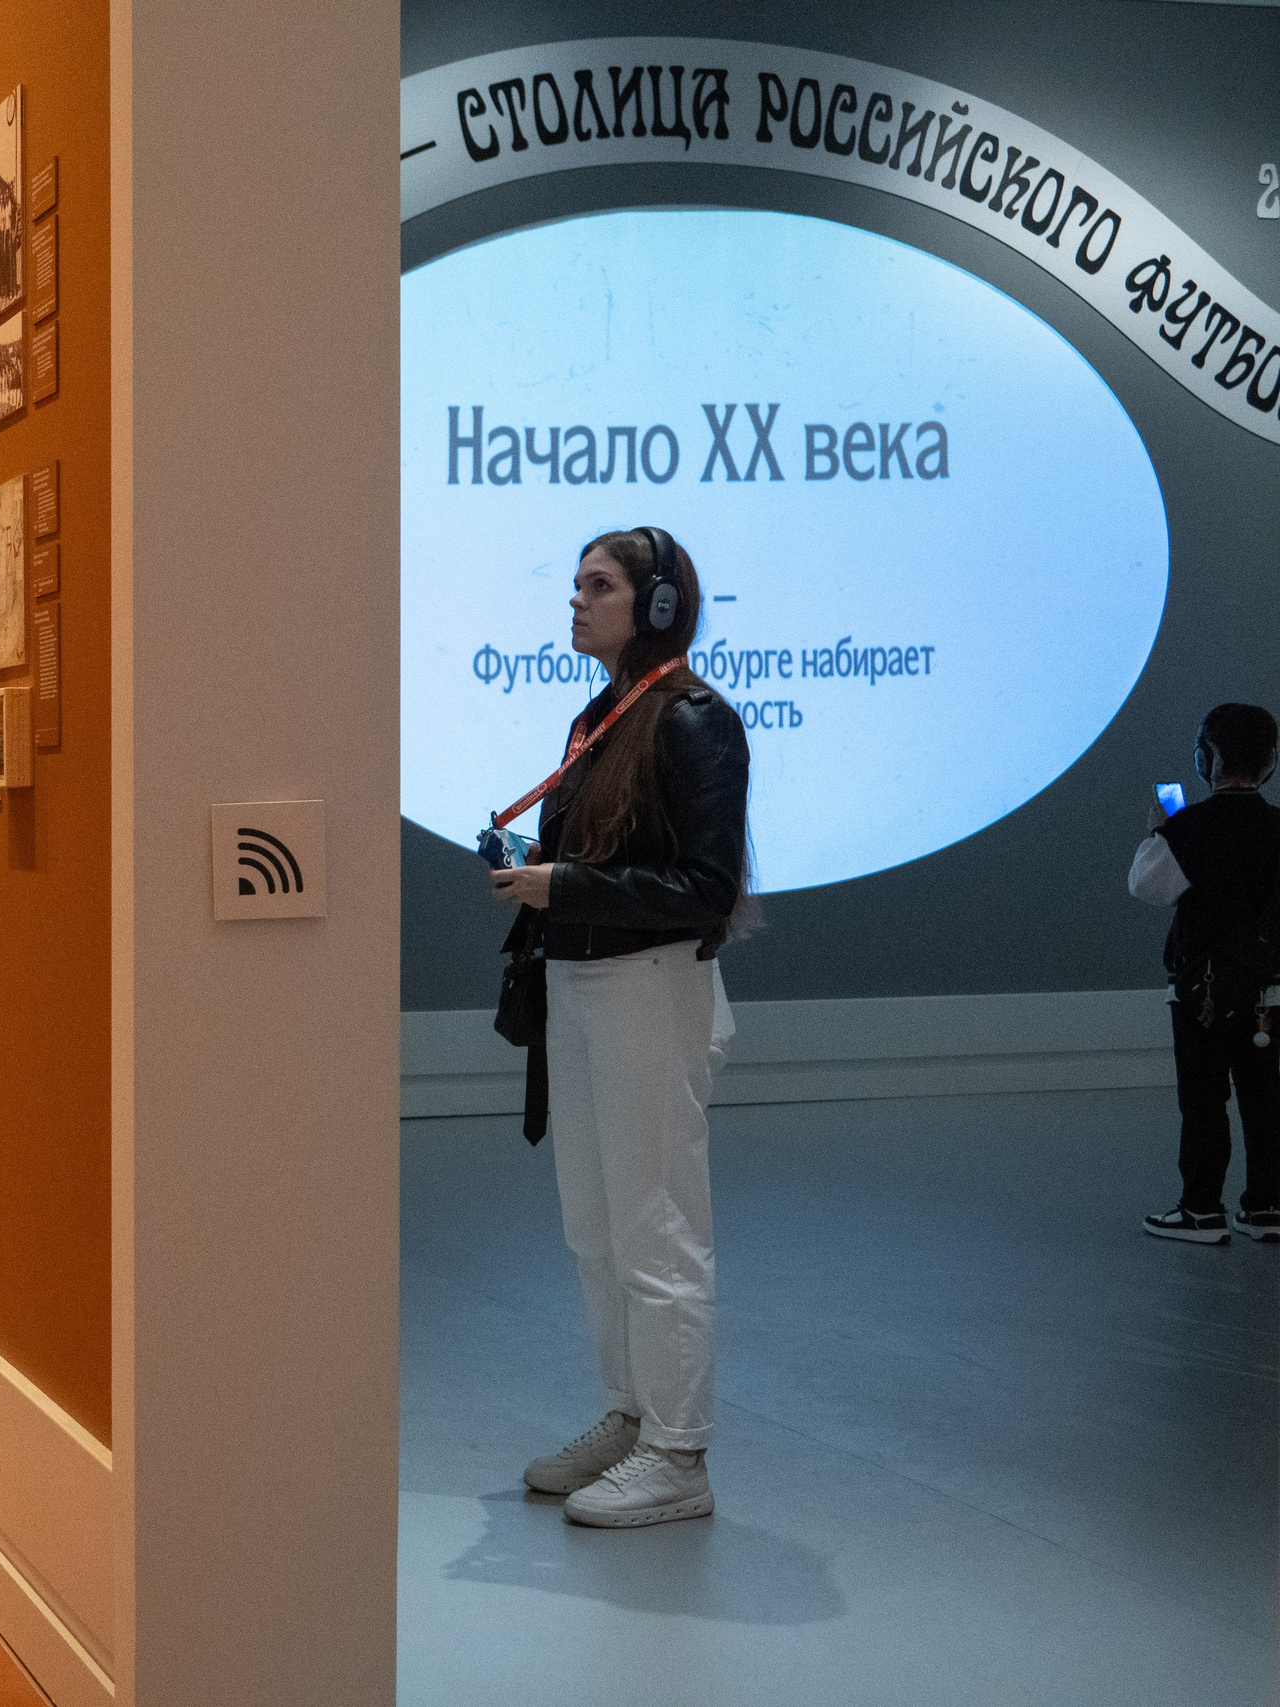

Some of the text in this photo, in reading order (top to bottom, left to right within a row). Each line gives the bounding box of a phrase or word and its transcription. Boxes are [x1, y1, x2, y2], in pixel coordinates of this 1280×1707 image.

[457, 65, 730, 162] СТОЛИЦА
[755, 71, 1122, 275] РОССИЙСКОГО
[1124, 253, 1280, 421] ФУТБО
[447, 405, 680, 486] Начало
[803, 420, 951, 482] века
[472, 641, 591, 694] Футбол
[689, 637, 792, 691] рбурге
[801, 635, 936, 686] набирает
